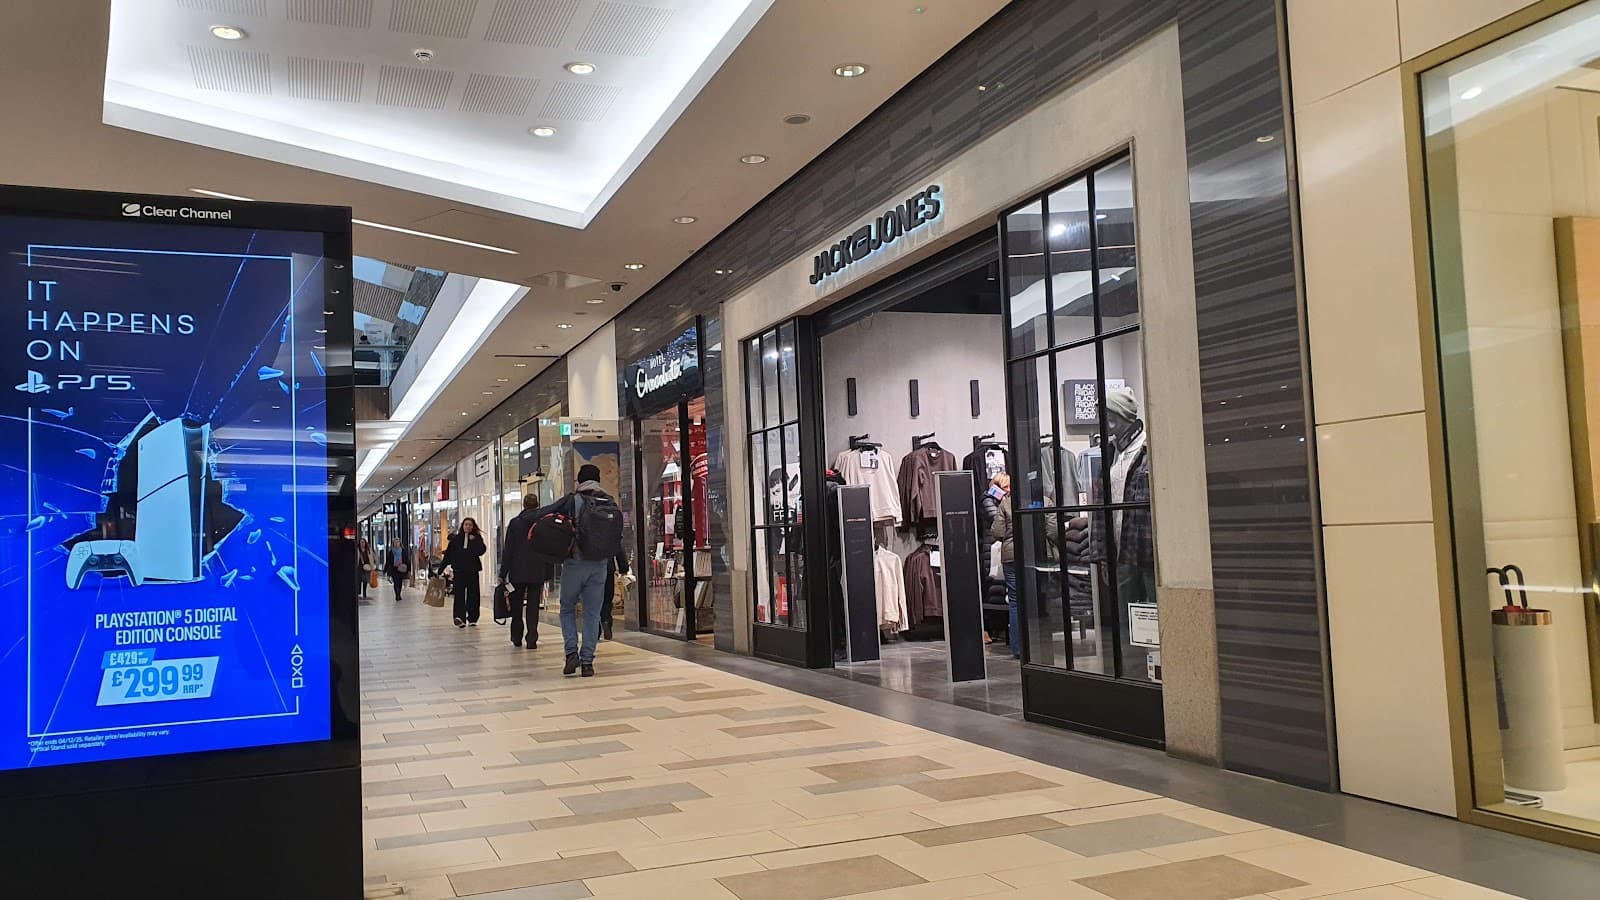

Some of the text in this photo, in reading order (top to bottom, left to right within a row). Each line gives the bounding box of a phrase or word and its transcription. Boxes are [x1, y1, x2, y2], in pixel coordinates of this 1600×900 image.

[142, 205, 232, 220] Clear Channel
[27, 280, 57, 301] IT
[27, 310, 195, 335] HAPPENS
[26, 340, 81, 361] ON
[184, 609, 192, 624] 5
[195, 607, 238, 623] DIGITAL
[115, 624, 222, 645] EDITION CONSOLE
